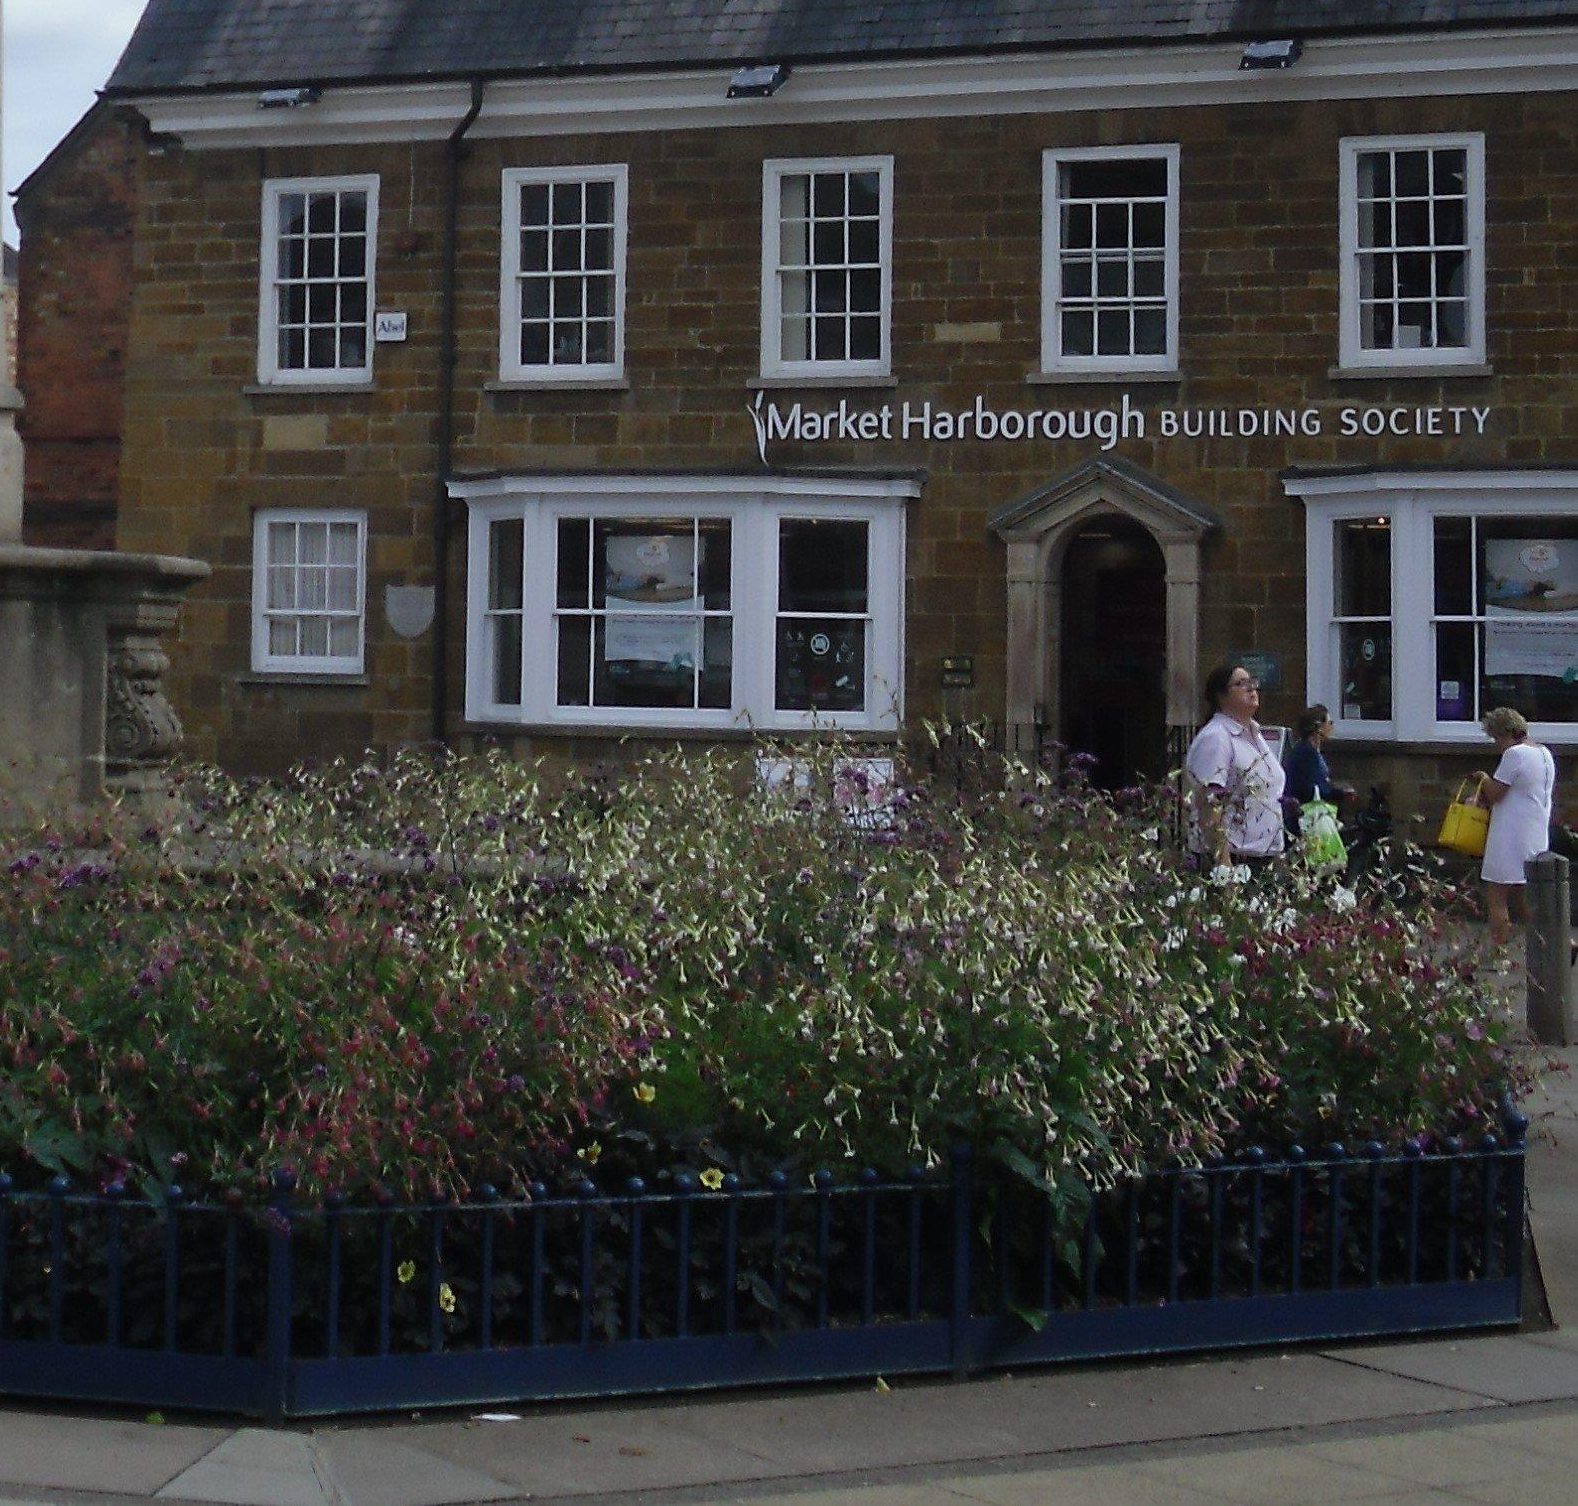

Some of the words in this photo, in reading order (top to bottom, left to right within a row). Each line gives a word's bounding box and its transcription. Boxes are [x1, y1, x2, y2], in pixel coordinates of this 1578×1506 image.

[767, 399, 893, 440] Market
[902, 394, 1145, 451] Harborough
[1160, 409, 1321, 437] BUILDING
[1340, 407, 1491, 435] SOCIETY
